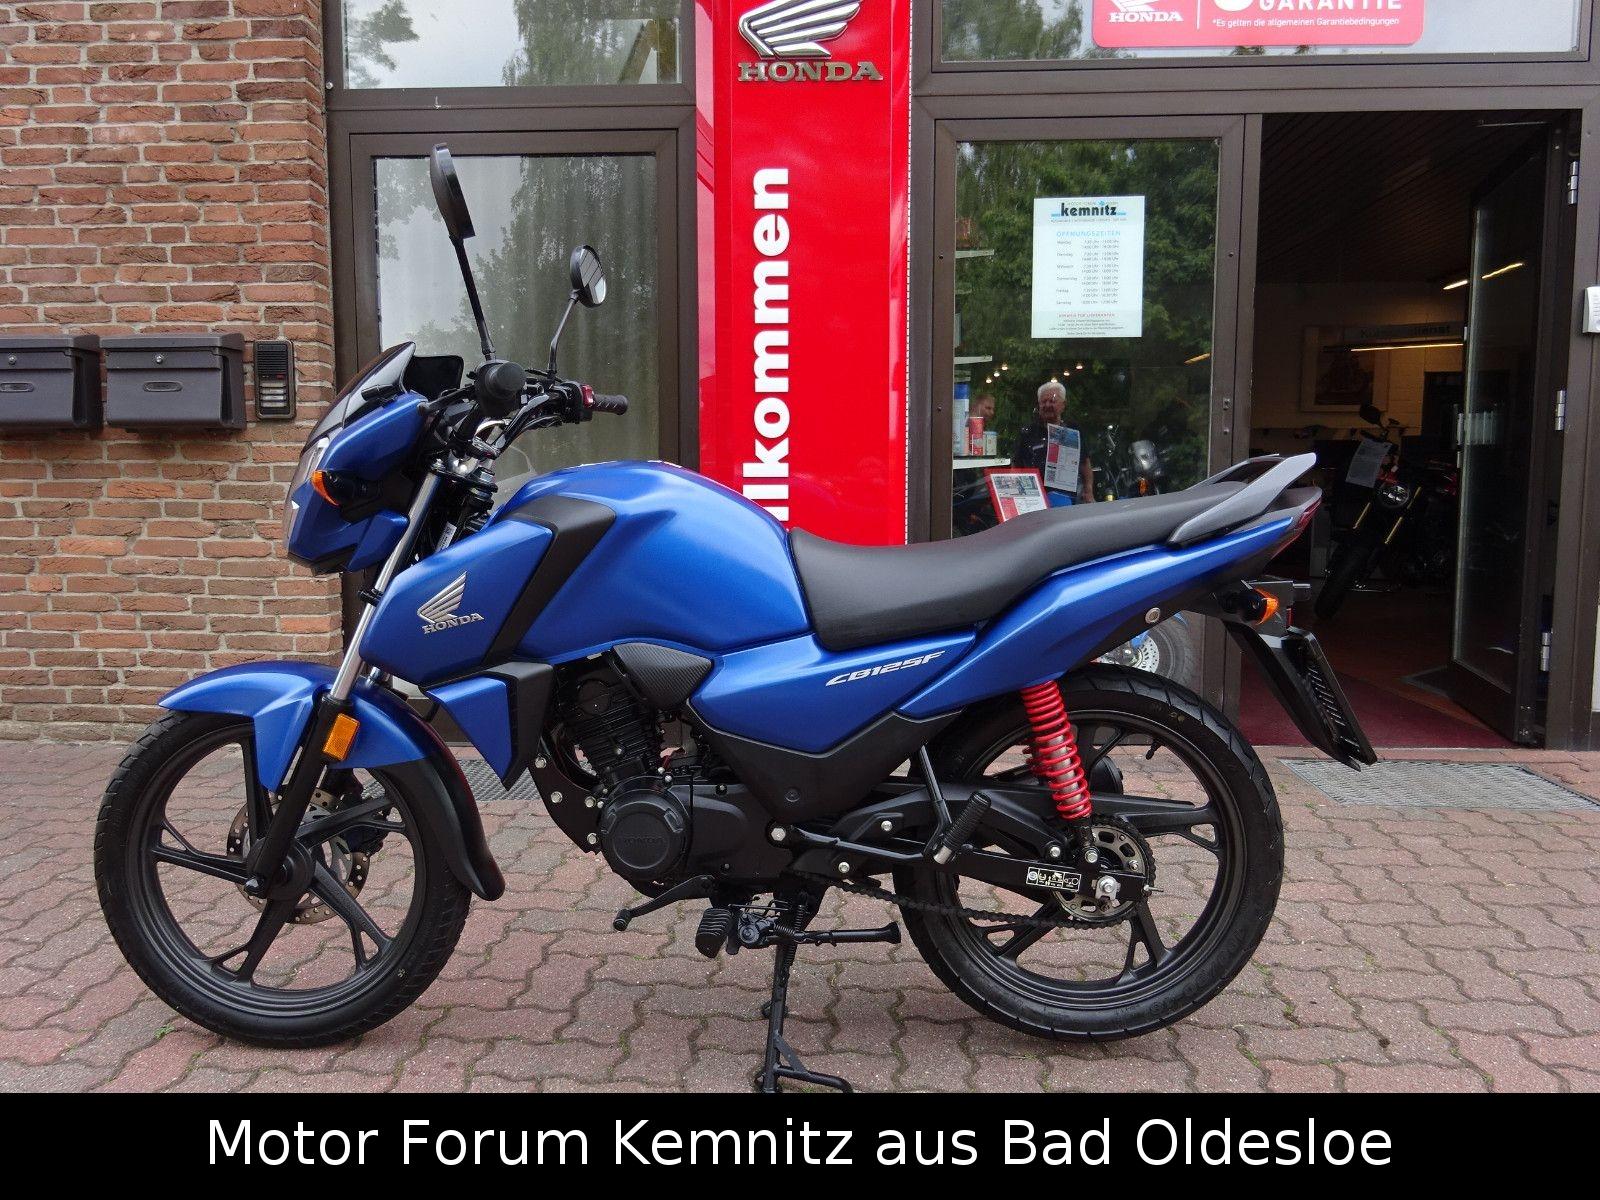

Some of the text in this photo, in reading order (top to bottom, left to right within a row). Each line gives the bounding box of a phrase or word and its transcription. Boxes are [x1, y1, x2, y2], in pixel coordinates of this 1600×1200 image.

[1109, 11, 1184, 23] HONDA
[1227, 18, 1252, 29] gelten
[1254, 18, 1266, 27] die
[1267, 17, 1315, 28] allgemeinen
[1316, 16, 1400, 27] Garantiebedingungen
[738, 61, 883, 82] HONDA
[1061, 203, 1117, 216] kemnitz
[422, 612, 485, 635] HONDA
[825, 650, 946, 687] CB125F
